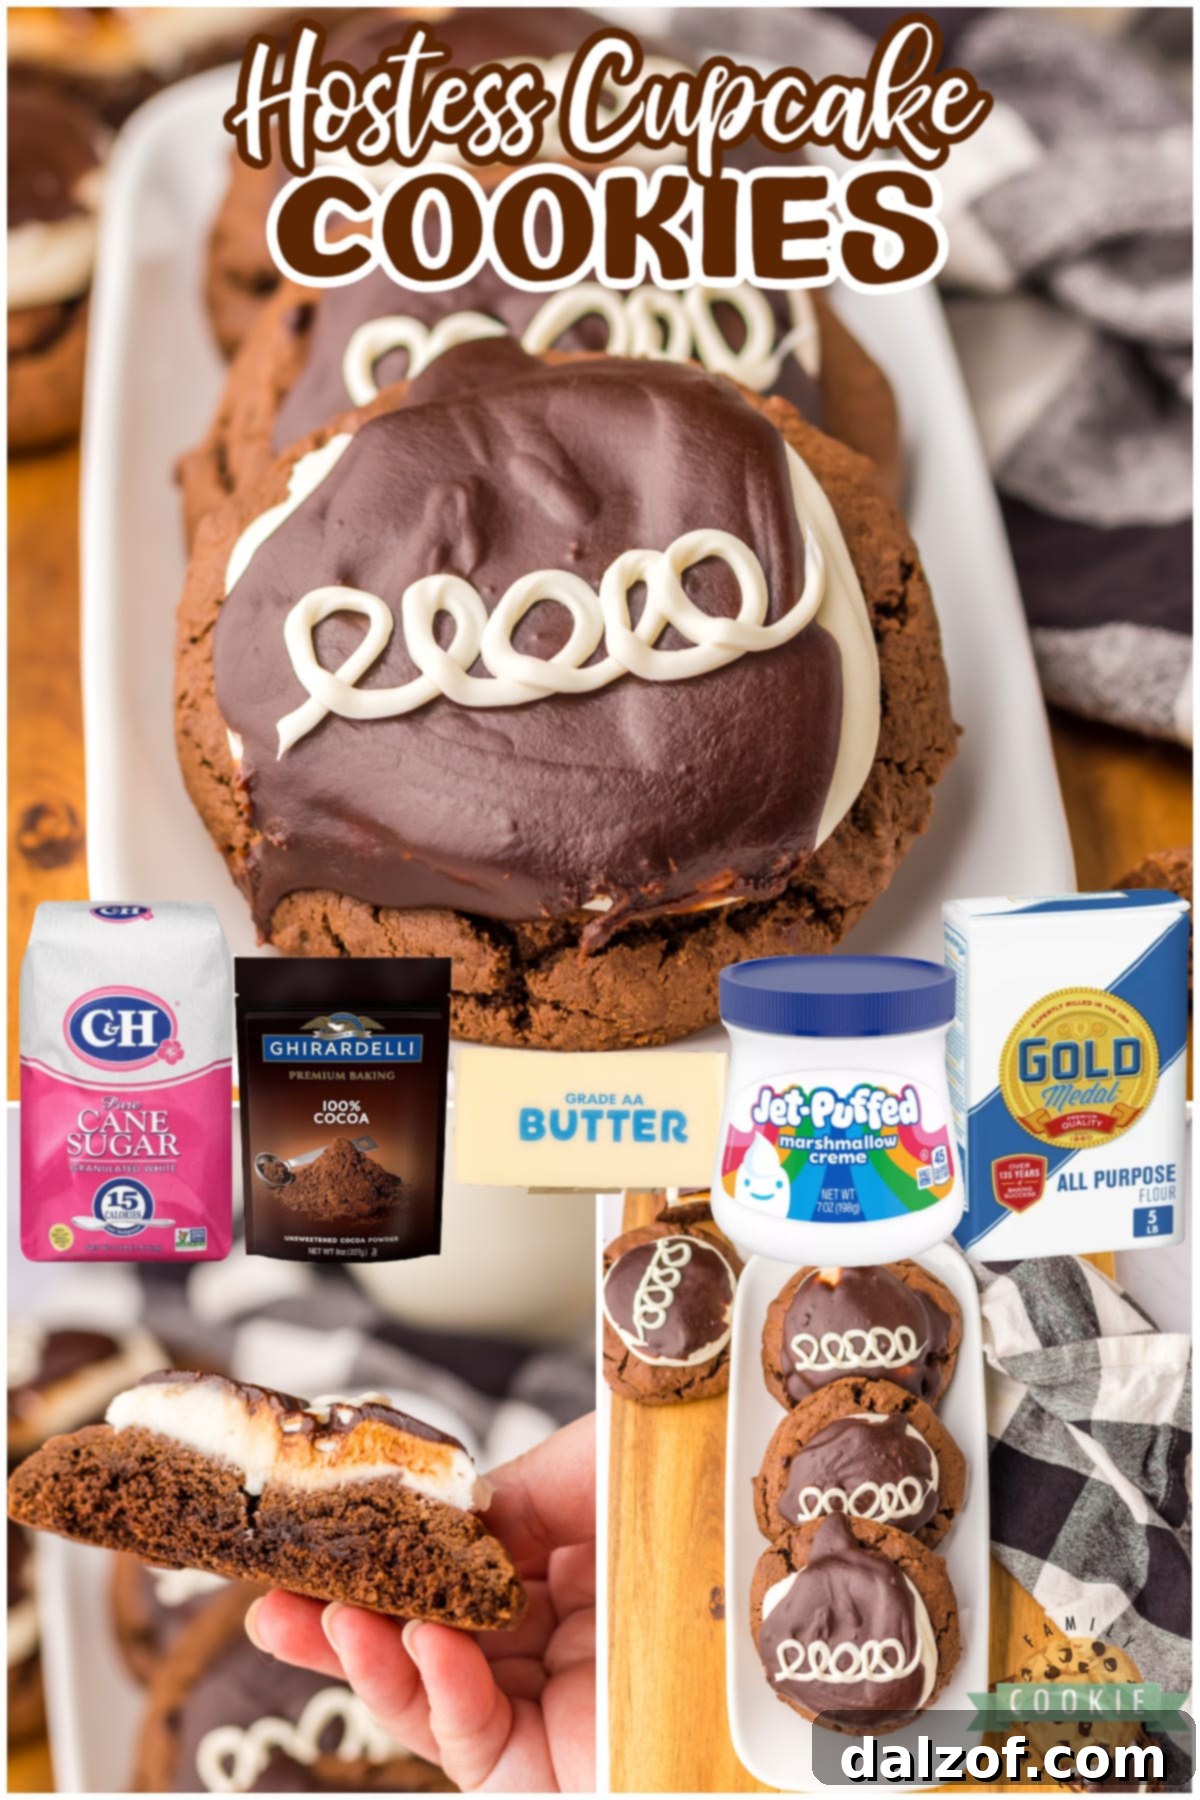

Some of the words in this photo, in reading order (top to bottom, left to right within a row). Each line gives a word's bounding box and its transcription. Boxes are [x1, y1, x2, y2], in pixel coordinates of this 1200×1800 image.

[1031, 1003, 1064, 1029] EXPERTLY
[1065, 1000, 1092, 1008] MILLED
[80, 1009, 159, 1048] C&H
[269, 1041, 415, 1056] GHIRARDELLI
[1018, 1037, 1142, 1083] GOLD
[288, 1071, 346, 1081] PREMIUM
[348, 1071, 396, 1081] BAKING
[101, 1096, 143, 1111] Pure
[564, 1093, 617, 1105] GRADE
[621, 1094, 644, 1106] AA
[1041, 1081, 1118, 1112] Medal
[322, 1100, 362, 1112] 100%
[753, 1088, 919, 1130] Jet-Puffed
[77, 1109, 169, 1134] CANE
[313, 1113, 370, 1124] COCOA
[518, 1107, 689, 1143] BUTTER
[1061, 1120, 1103, 1131] QUALITY
[66, 1133, 182, 1157] SUGAR
[779, 1135, 899, 1150] marshmallow
[808, 1152, 868, 1165] creme
[934, 1149, 946, 1164] 45
[71, 1164, 140, 1173] GRANULATED
[144, 1164, 176, 1173] WHITE
[1008, 1162, 1031, 1170] OVER
[1014, 1169, 1040, 1179] YEARS
[1057, 1172, 1088, 1192] ALL
[1094, 1163, 1176, 1190] PURPOSE
[106, 1191, 139, 1211] 15
[821, 1188, 839, 1200] NET
[841, 1188, 855, 1200] WT
[1138, 1185, 1177, 1203] FLOUR
[104, 1210, 142, 1220] CALORIES
[1147, 1208, 1157, 1225] 5
[1146, 1225, 1159, 1235] LB
[284, 1235, 338, 1244] UNSWEETENED
[367, 1235, 400, 1243] POWDER
[308, 1247, 321, 1255] NET
[322, 1247, 334, 1256] WT
